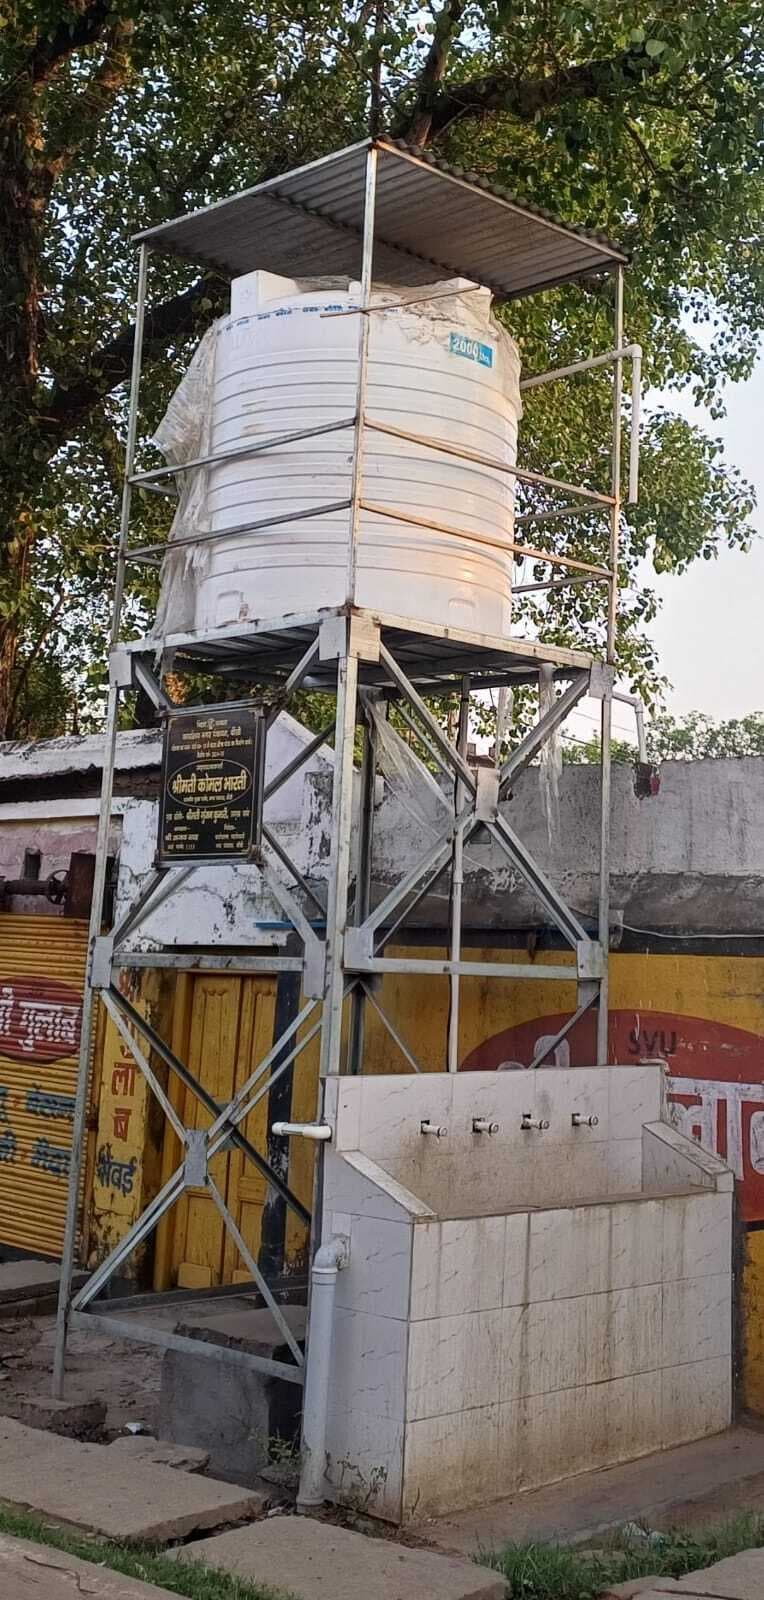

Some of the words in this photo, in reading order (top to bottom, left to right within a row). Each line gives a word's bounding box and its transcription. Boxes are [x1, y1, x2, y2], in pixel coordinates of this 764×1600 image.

[451, 336, 480, 361] 2000
[172, 773, 196, 794] श्रीमती
[198, 772, 223, 793] कोमल
[223, 769, 247, 791] भारती
[18, 1001, 82, 1051] गुलाब
[629, 1029, 677, 1056] SVU
